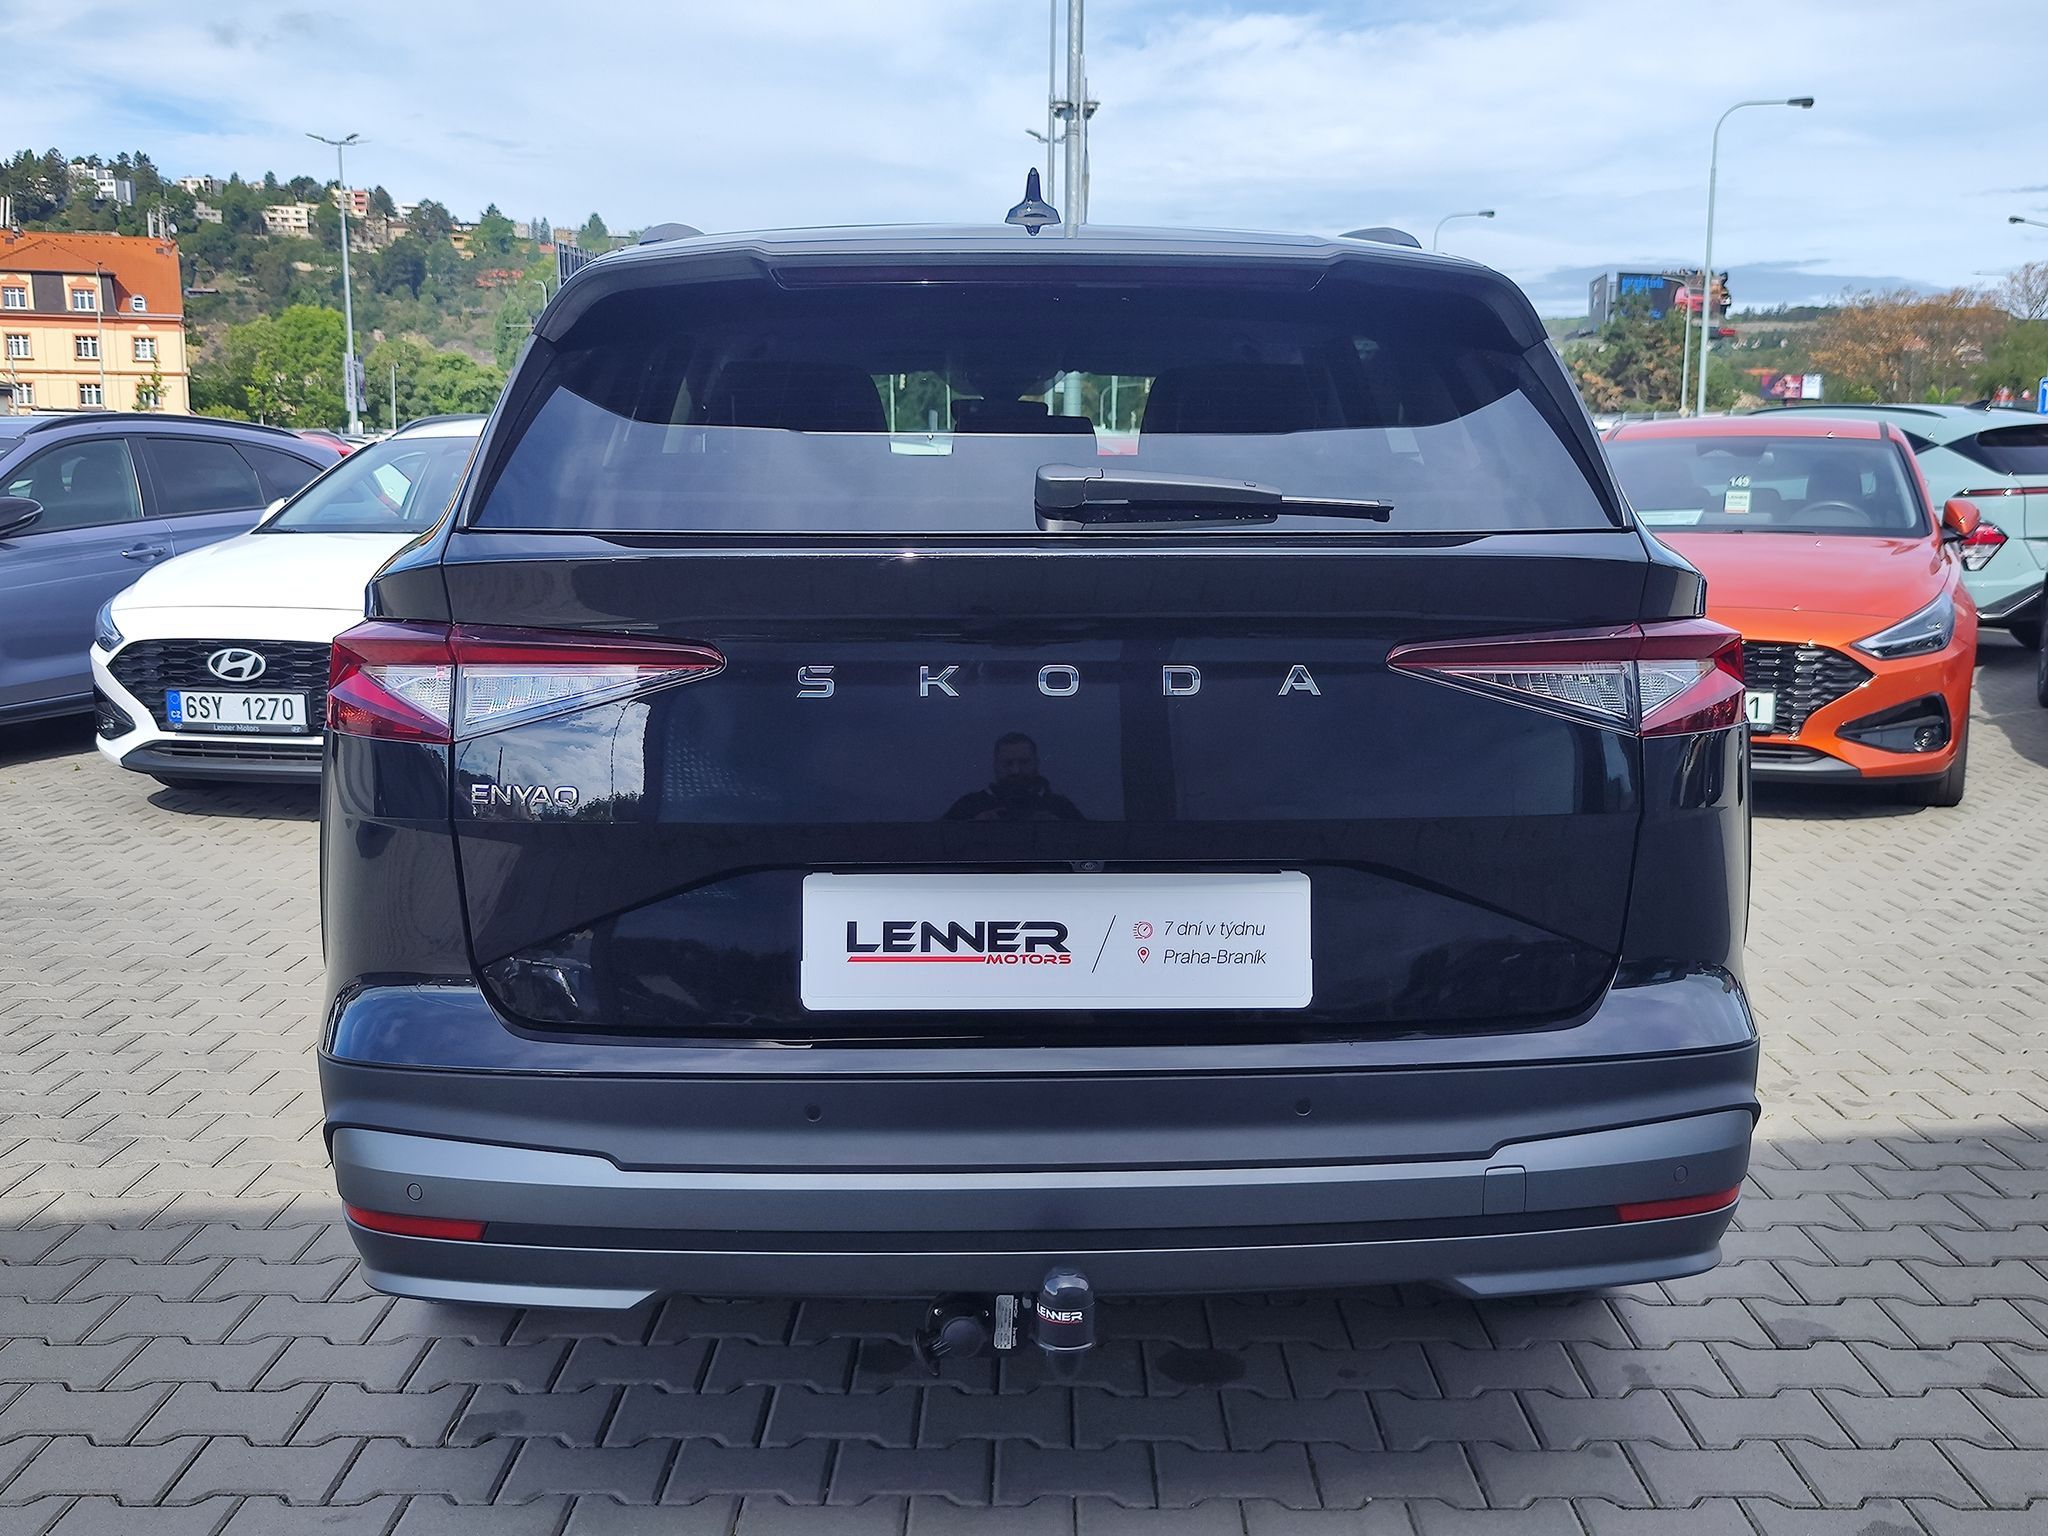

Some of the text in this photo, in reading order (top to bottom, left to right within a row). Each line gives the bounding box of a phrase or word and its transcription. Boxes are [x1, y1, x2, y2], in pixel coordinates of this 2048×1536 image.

[1729, 476, 1750, 487] 149
[171, 710, 182, 719] CZ
[186, 695, 294, 721] 6SY 1270
[213, 723, 260, 733] Lenner Motors
[471, 784, 580, 810] ENYAQ
[847, 921, 1071, 953] LENNER
[1164, 921, 1266, 940] 7 dní v týdnu
[986, 954, 1072, 964] MOTORS
[1163, 949, 1267, 964] Praha-Braník
[1036, 1302, 1084, 1321] LENNER
